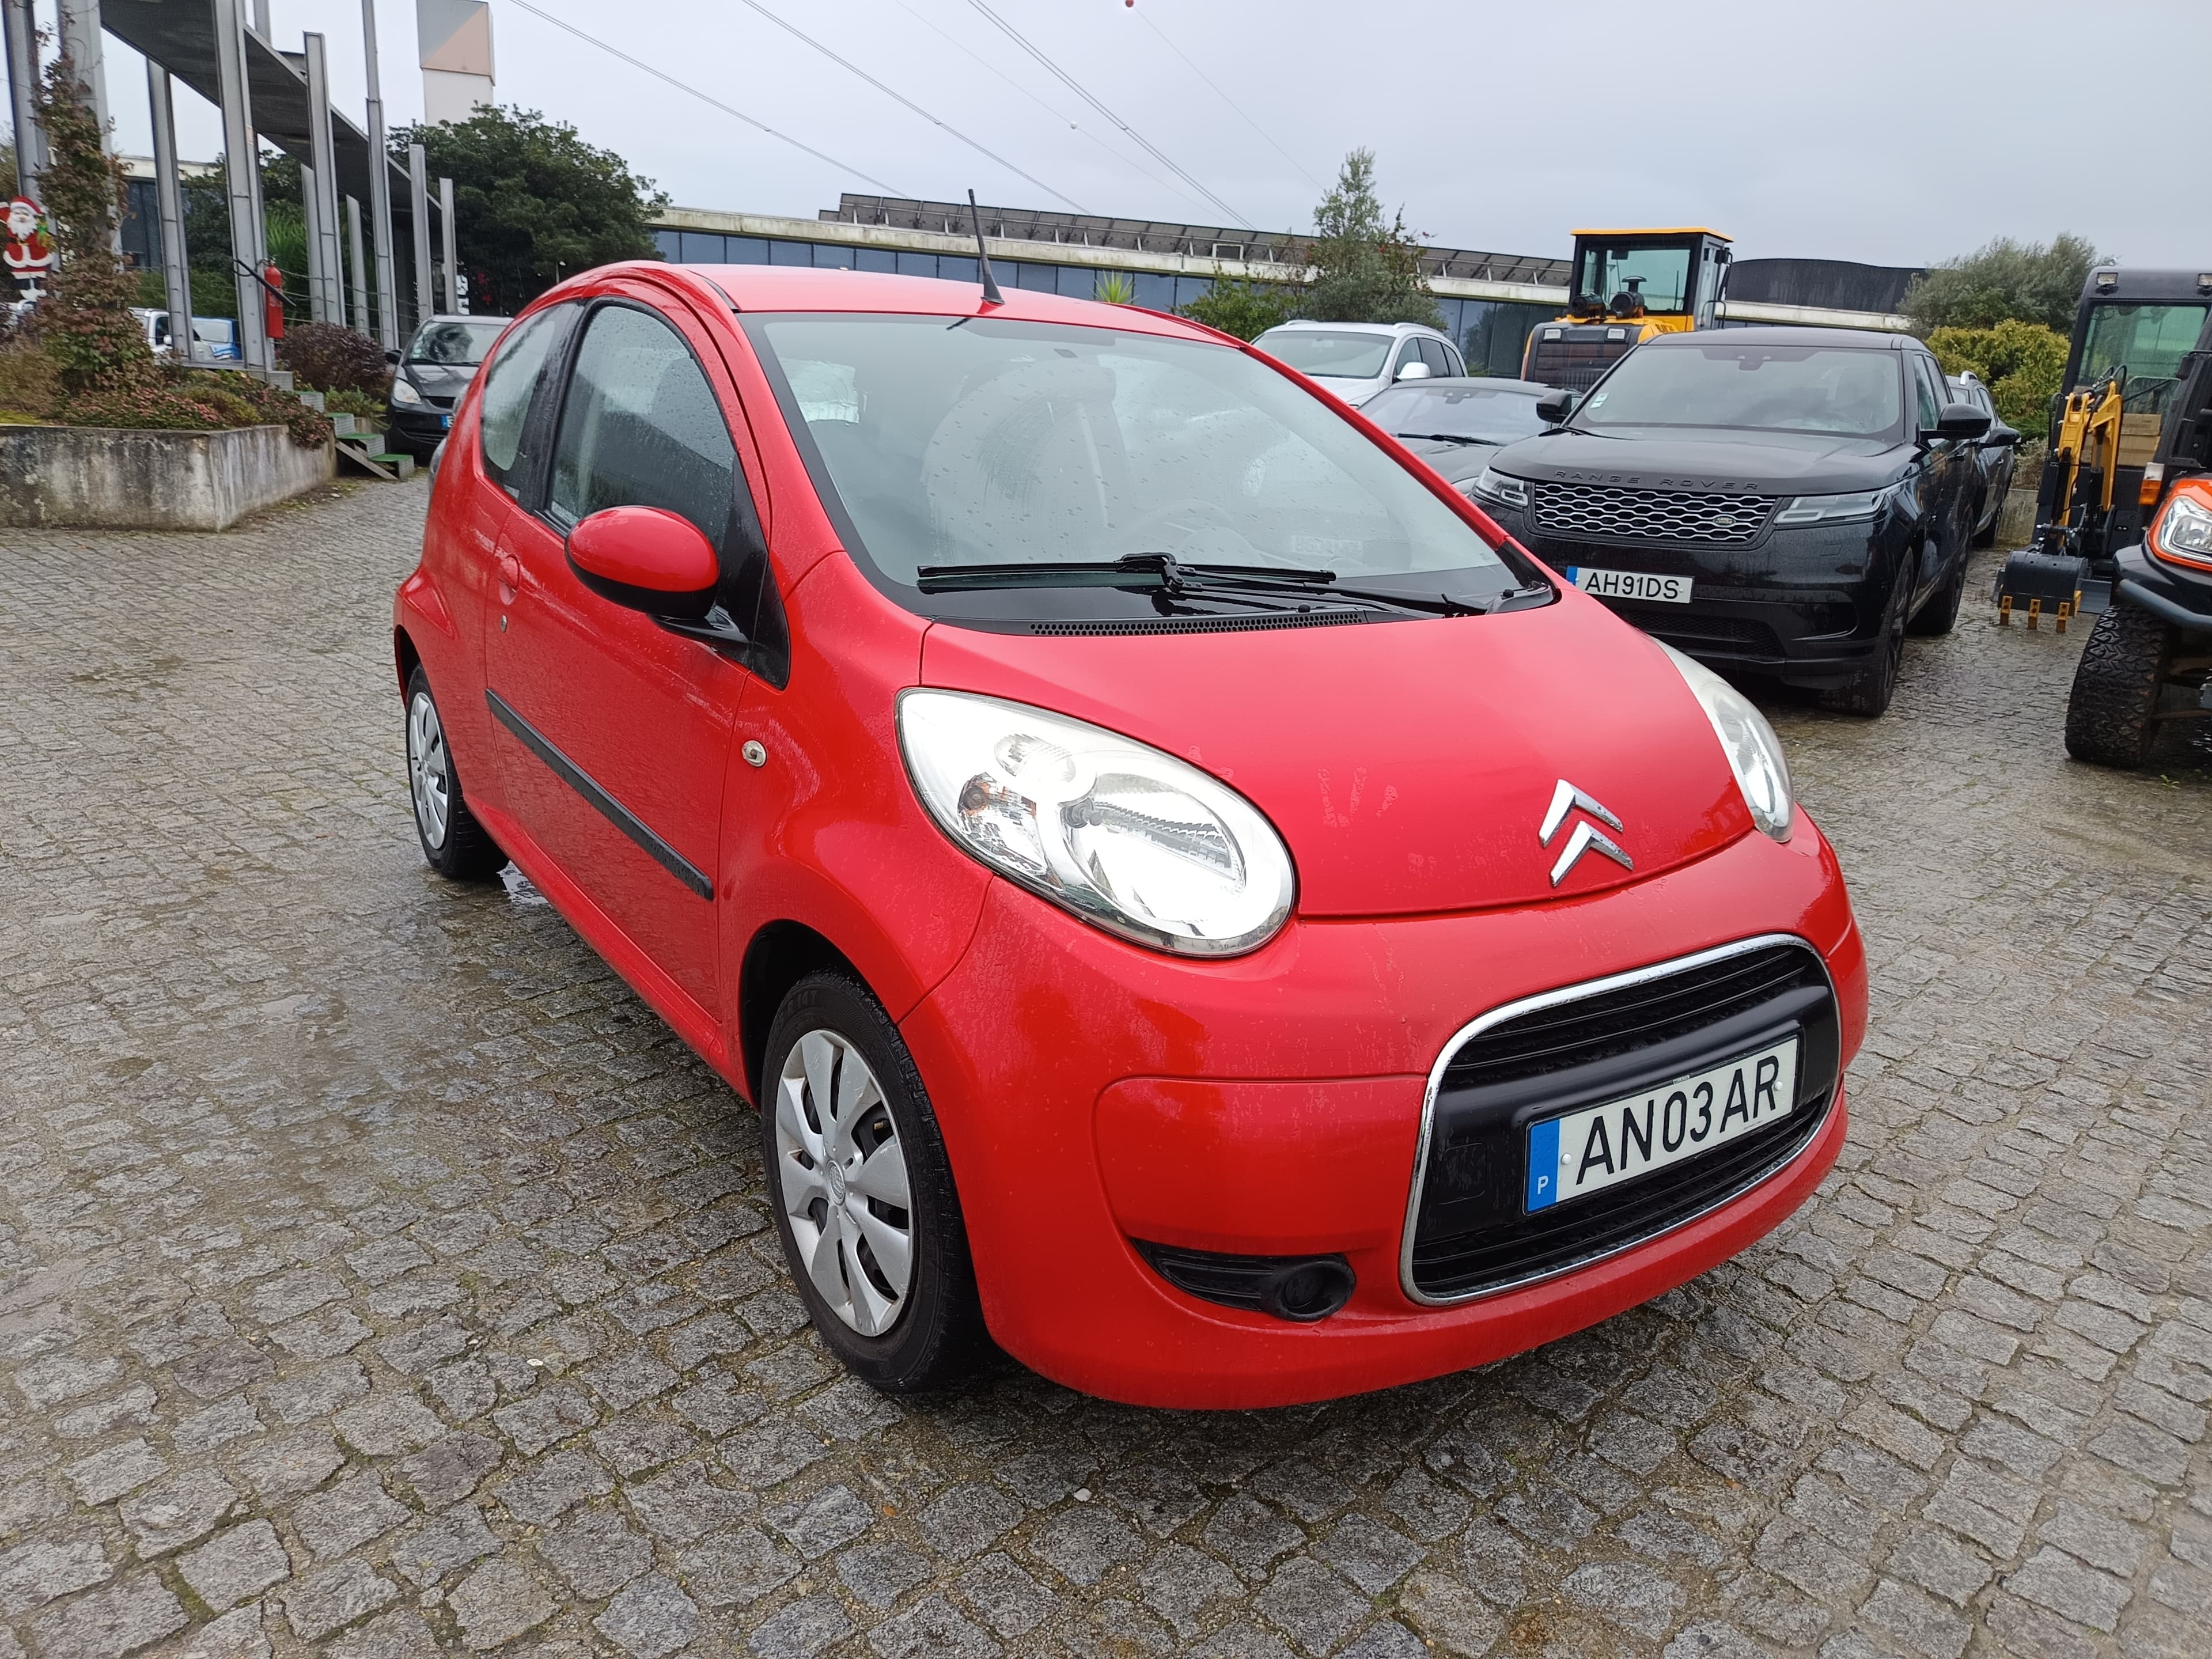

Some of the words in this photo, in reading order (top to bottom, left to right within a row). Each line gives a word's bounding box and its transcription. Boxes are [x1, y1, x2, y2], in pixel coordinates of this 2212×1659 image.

[1554, 470, 1641, 484] RANGE
[1659, 478, 1759, 490] ROVER
[1585, 572, 1680, 599] AH91DS
[1575, 1055, 1780, 1185] AN03AR
[1537, 1175, 1549, 1195] P
